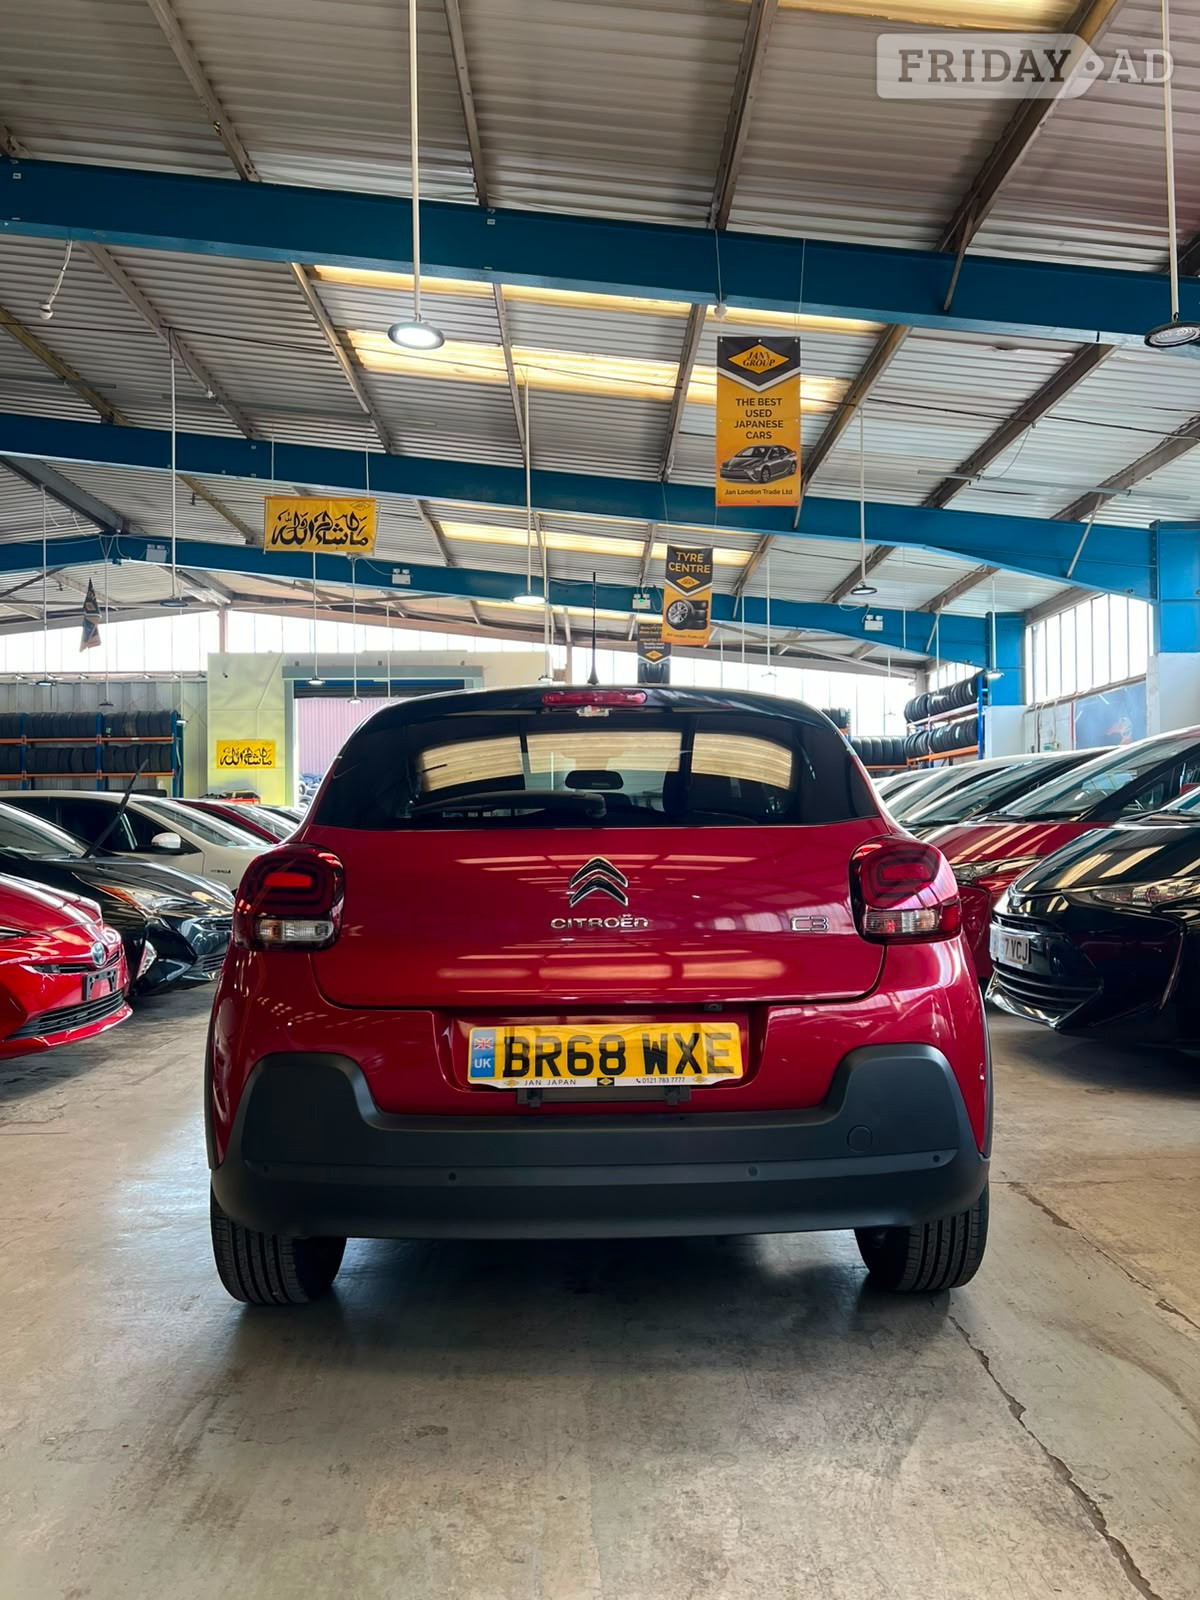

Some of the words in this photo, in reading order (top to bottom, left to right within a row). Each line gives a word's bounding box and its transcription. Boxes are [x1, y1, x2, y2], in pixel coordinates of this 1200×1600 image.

[742, 359, 776, 367] GROUP
[735, 398, 755, 407] THE
[757, 398, 783, 407] BEST
[745, 409, 773, 418] USED
[734, 420, 784, 429] JAPANESE
[745, 431, 773, 440] CARS
[676, 552, 705, 563] TYRE
[668, 562, 711, 574] CENTRE
[550, 914, 649, 930] CITROËN
[790, 915, 829, 932] C3
[1010, 939, 1028, 961] YCJ
[503, 1034, 626, 1078] BR68
[642, 1032, 734, 1075] WXE
[474, 1058, 491, 1068] UK
